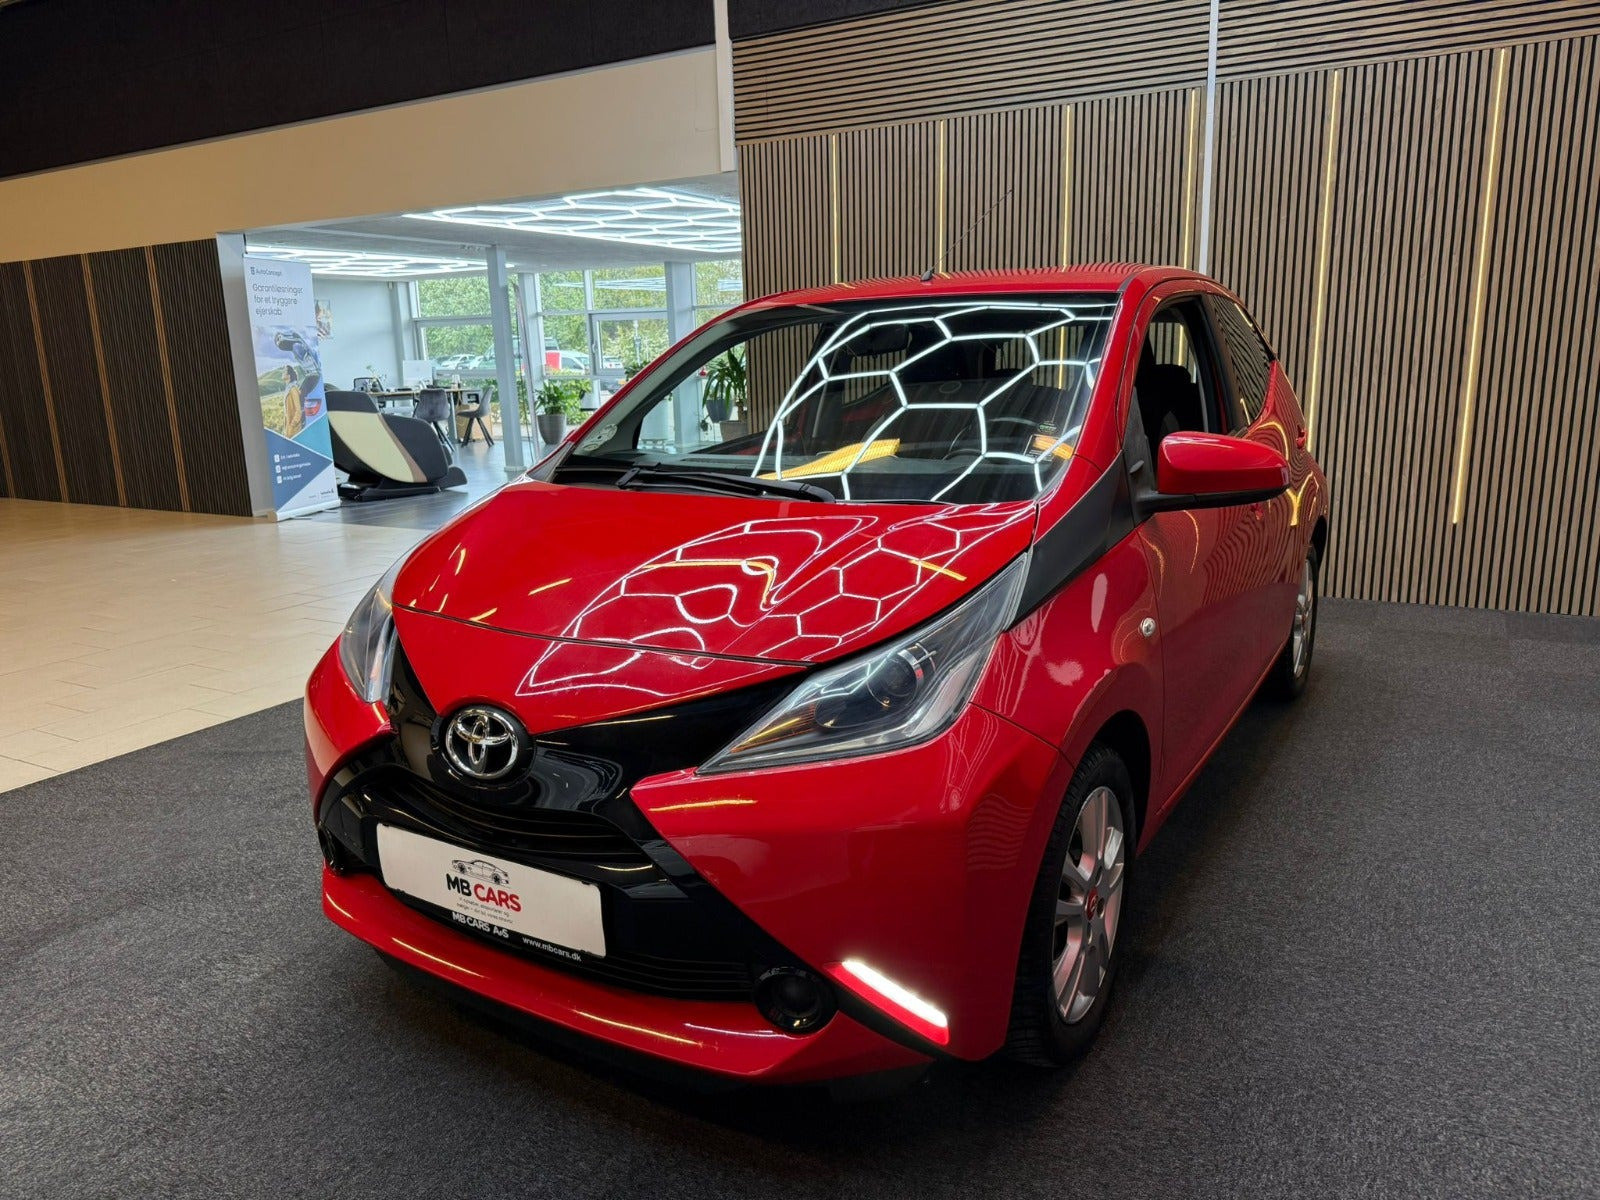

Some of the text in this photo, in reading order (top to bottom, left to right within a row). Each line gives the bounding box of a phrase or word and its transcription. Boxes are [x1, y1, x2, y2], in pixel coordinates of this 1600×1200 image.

[254, 294, 264, 303] for
[446, 873, 472, 897] MB
[473, 883, 522, 912] CARS
[522, 936, 582, 961] www.mbcars.dk
